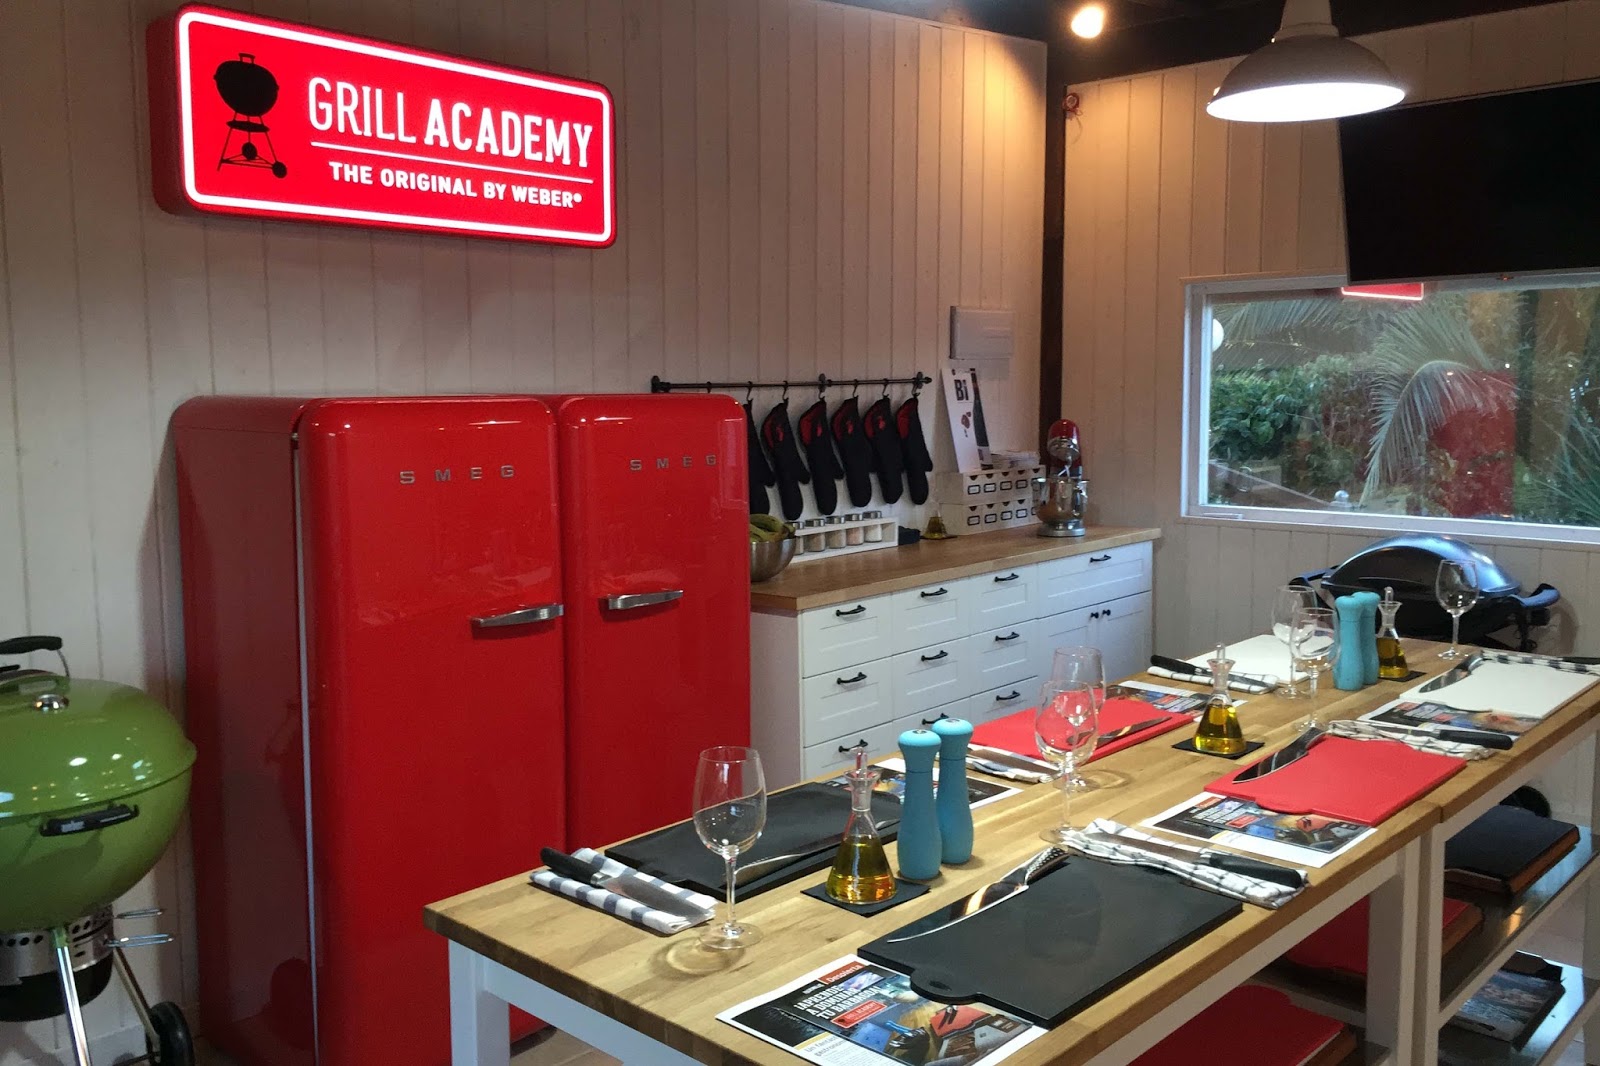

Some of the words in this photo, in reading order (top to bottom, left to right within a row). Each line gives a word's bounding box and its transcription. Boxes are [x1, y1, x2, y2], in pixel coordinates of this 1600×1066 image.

[308, 77, 416, 144] GRILL
[424, 98, 593, 168] ACADEMY
[328, 161, 373, 185] THE
[380, 168, 477, 197] ORIGINAL
[483, 181, 506, 200] BY
[630, 454, 717, 471] SMEG
[400, 464, 514, 484] SMEG
[816, 1009, 836, 1019] TU
